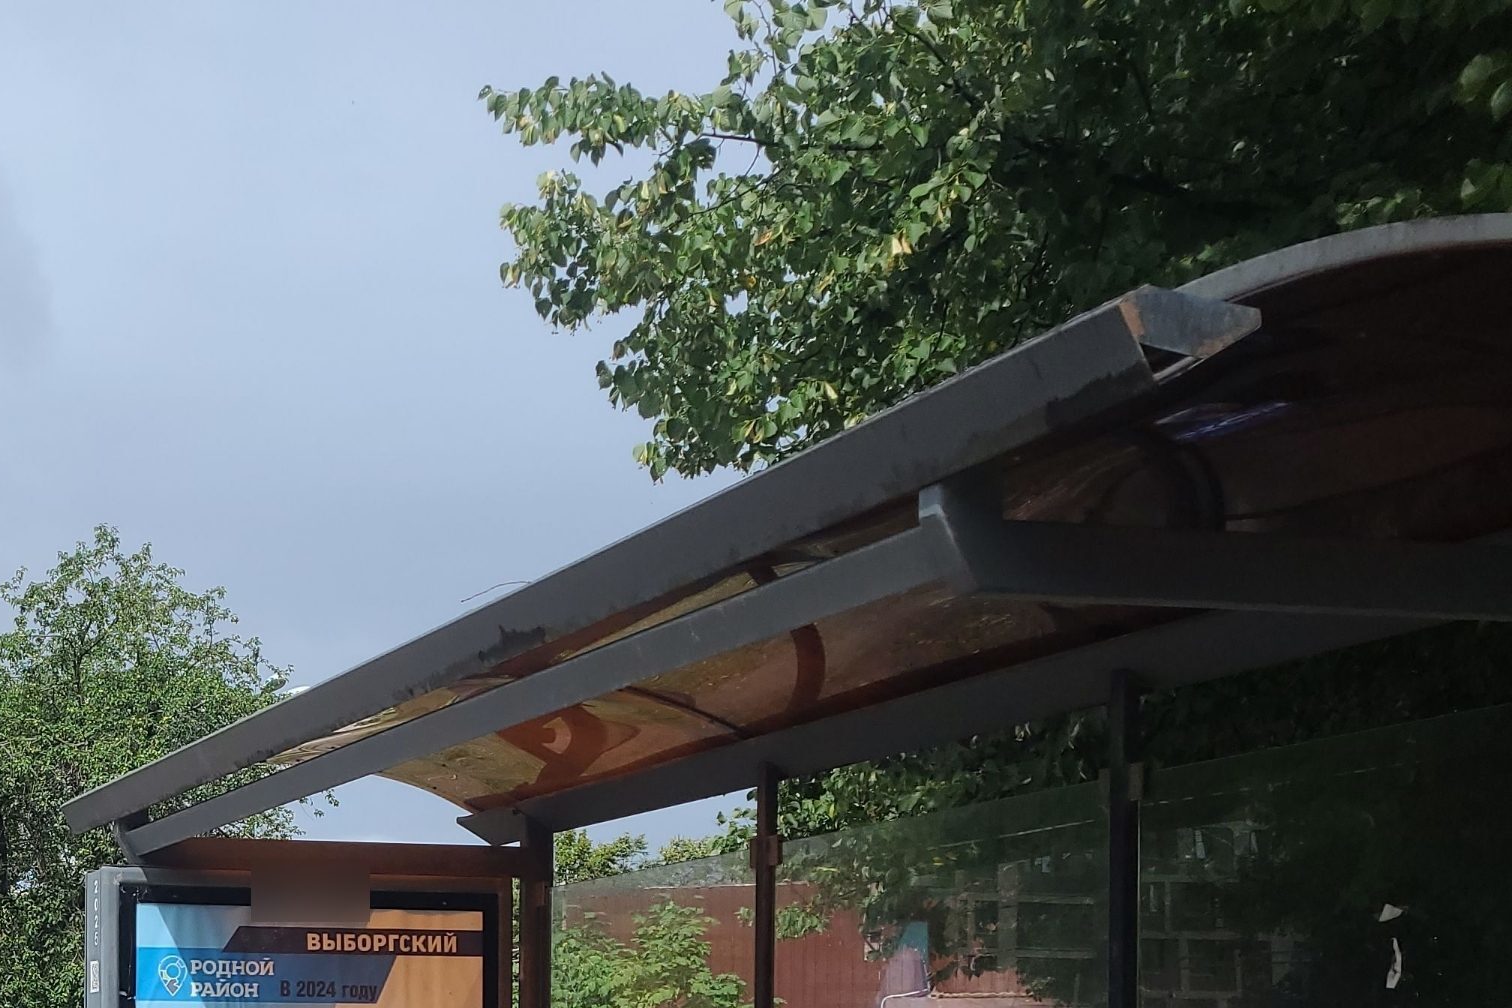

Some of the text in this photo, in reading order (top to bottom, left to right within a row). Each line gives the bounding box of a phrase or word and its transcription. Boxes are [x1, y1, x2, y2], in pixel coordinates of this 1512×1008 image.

[306, 932, 458, 953] ВЫБОРГСКИЙ
[190, 956, 275, 979] РОДНОЙ
[190, 981, 259, 998] РАЙОН
[280, 980, 377, 1002] В 2024 году
